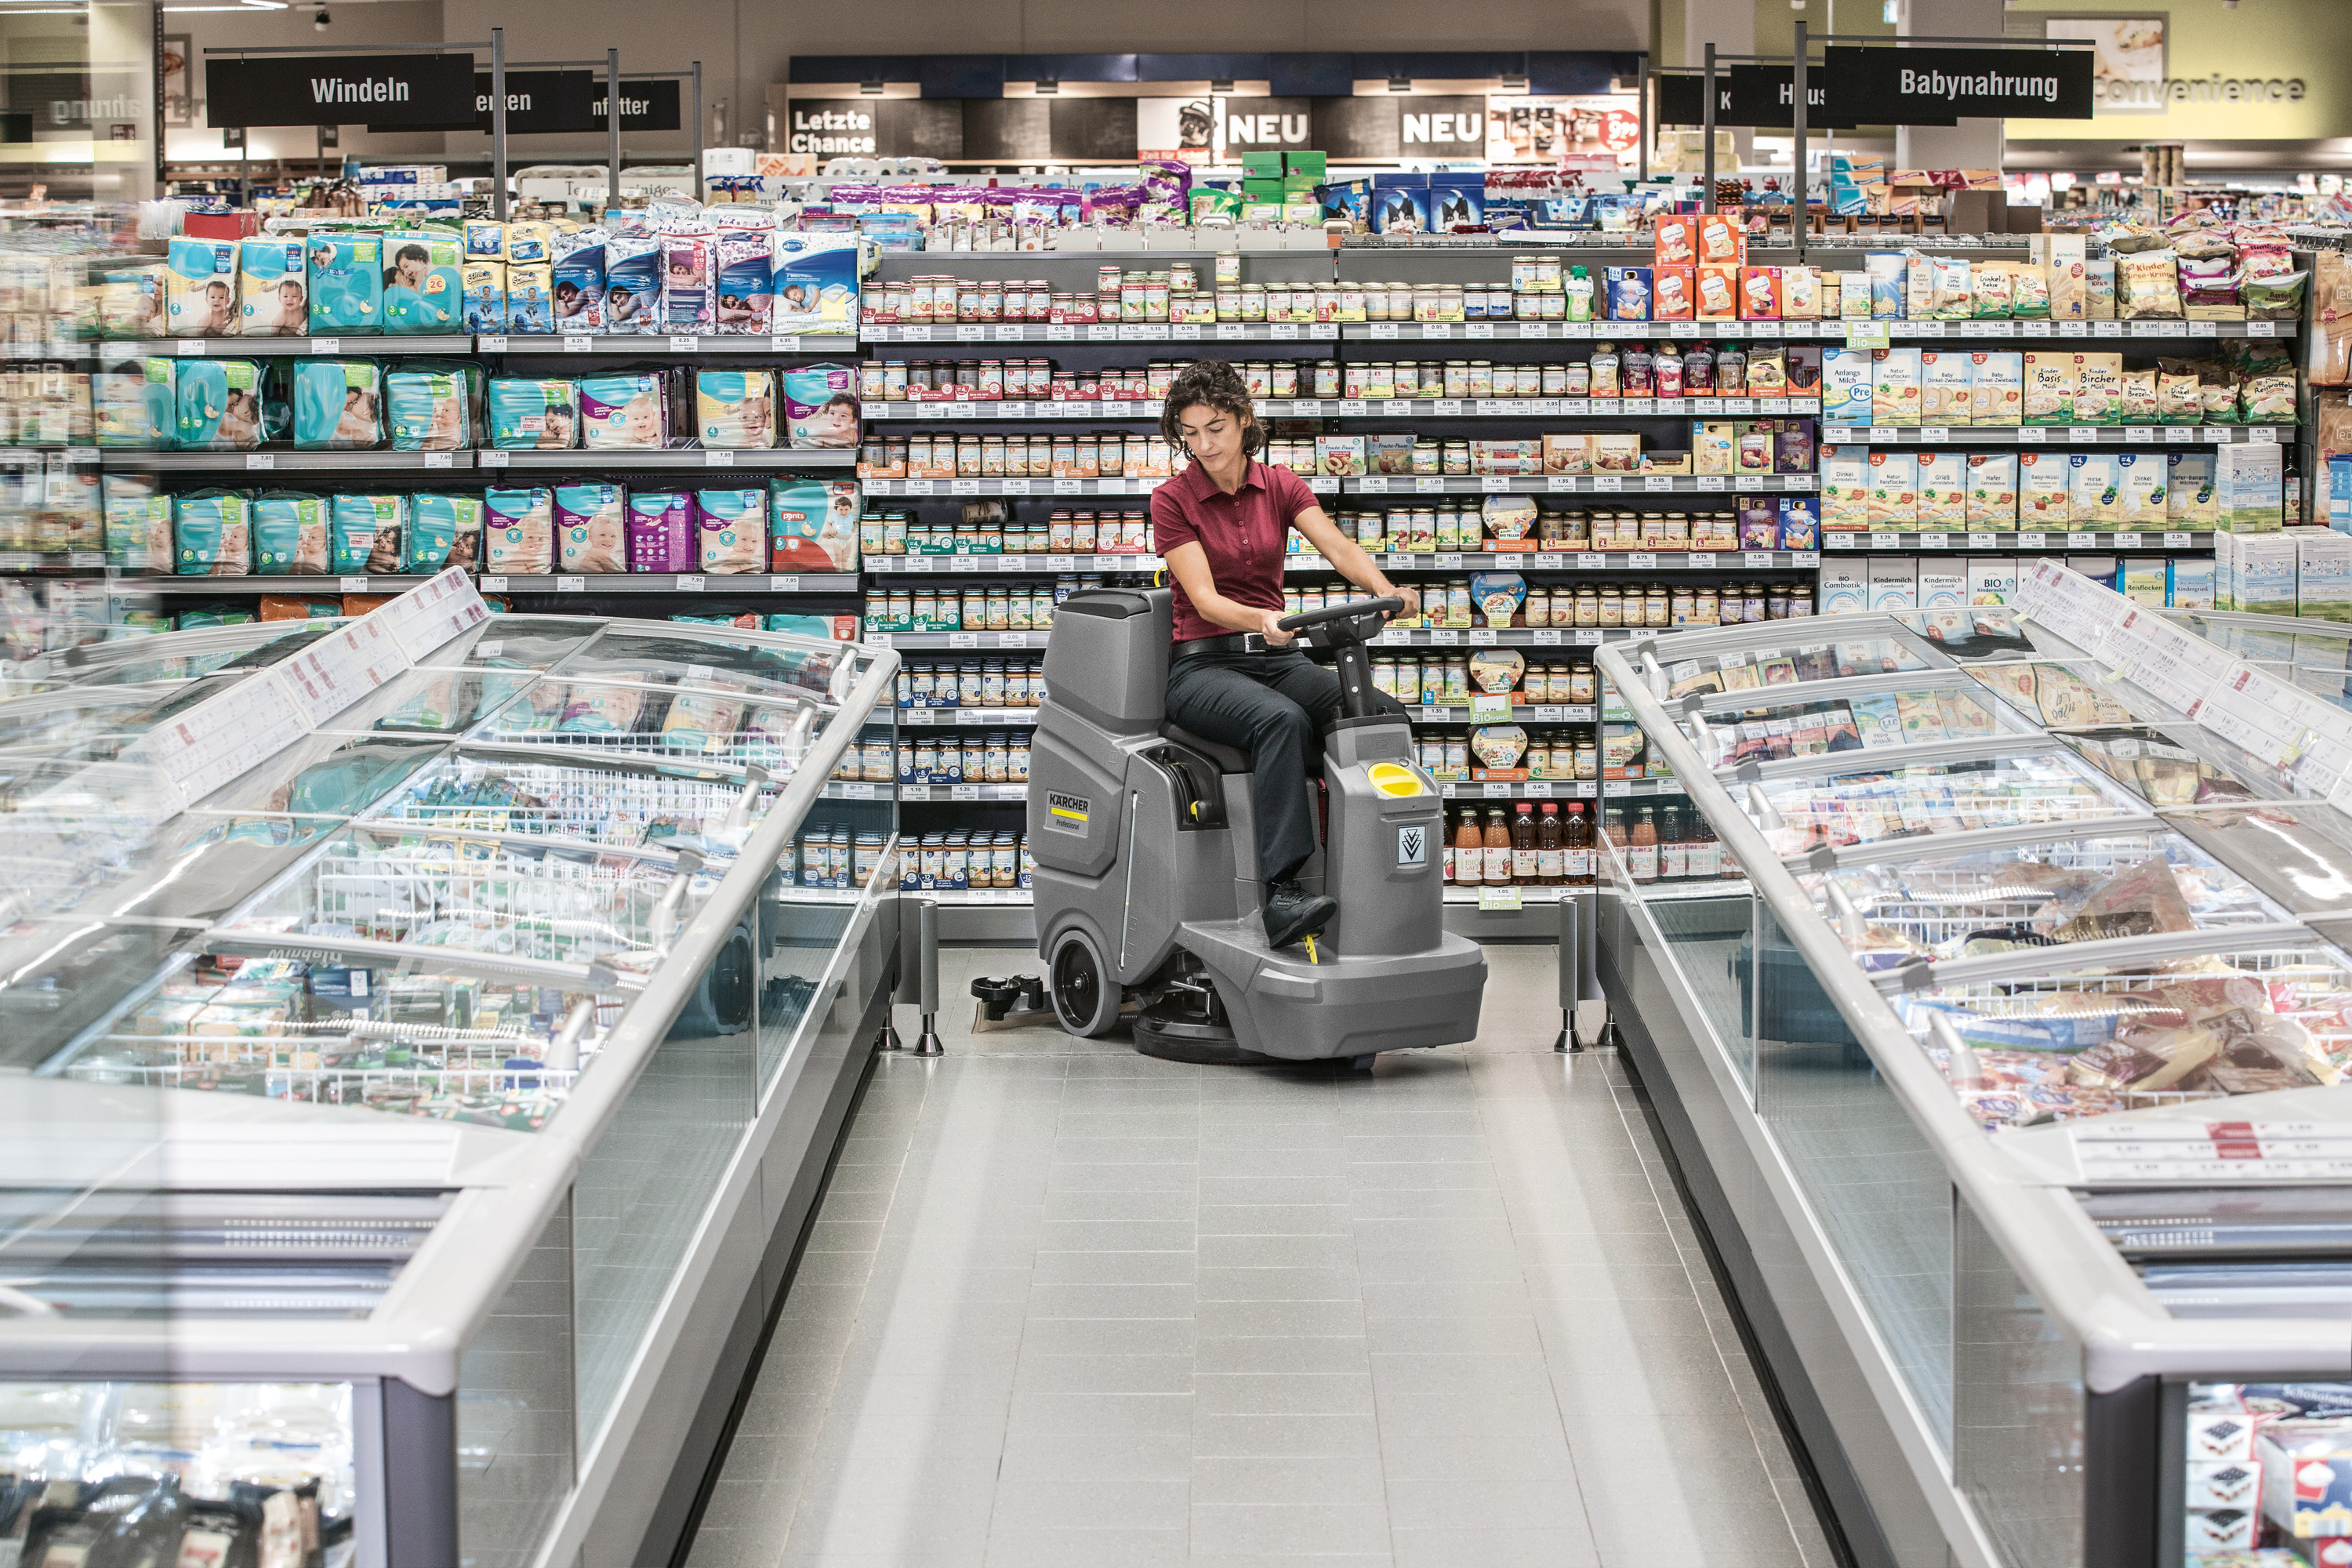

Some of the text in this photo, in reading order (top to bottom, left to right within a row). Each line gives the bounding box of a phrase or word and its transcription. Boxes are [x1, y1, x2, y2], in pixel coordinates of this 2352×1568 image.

[311, 77, 409, 103] Windeln
[1900, 69, 2058, 102] Babynahrung
[1780, 83, 1825, 106] Hus
[795, 110, 872, 131] Letzte
[1403, 113, 1482, 143] NEU
[1229, 114, 1308, 143] NEU
[791, 133, 876, 154] Chance
[2136, 263, 2167, 272] Kinder
[429, 279, 443, 289] 2€
[2038, 373, 2061, 383] Basis
[2080, 373, 2116, 383] Bircher
[1854, 387, 1870, 396] Pre
[2254, 382, 2295, 394] Reiswaffeln
[783, 512, 804, 521] pants
[1049, 793, 1088, 812] KÄRCHER
[1056, 818, 1080, 830] Professional
